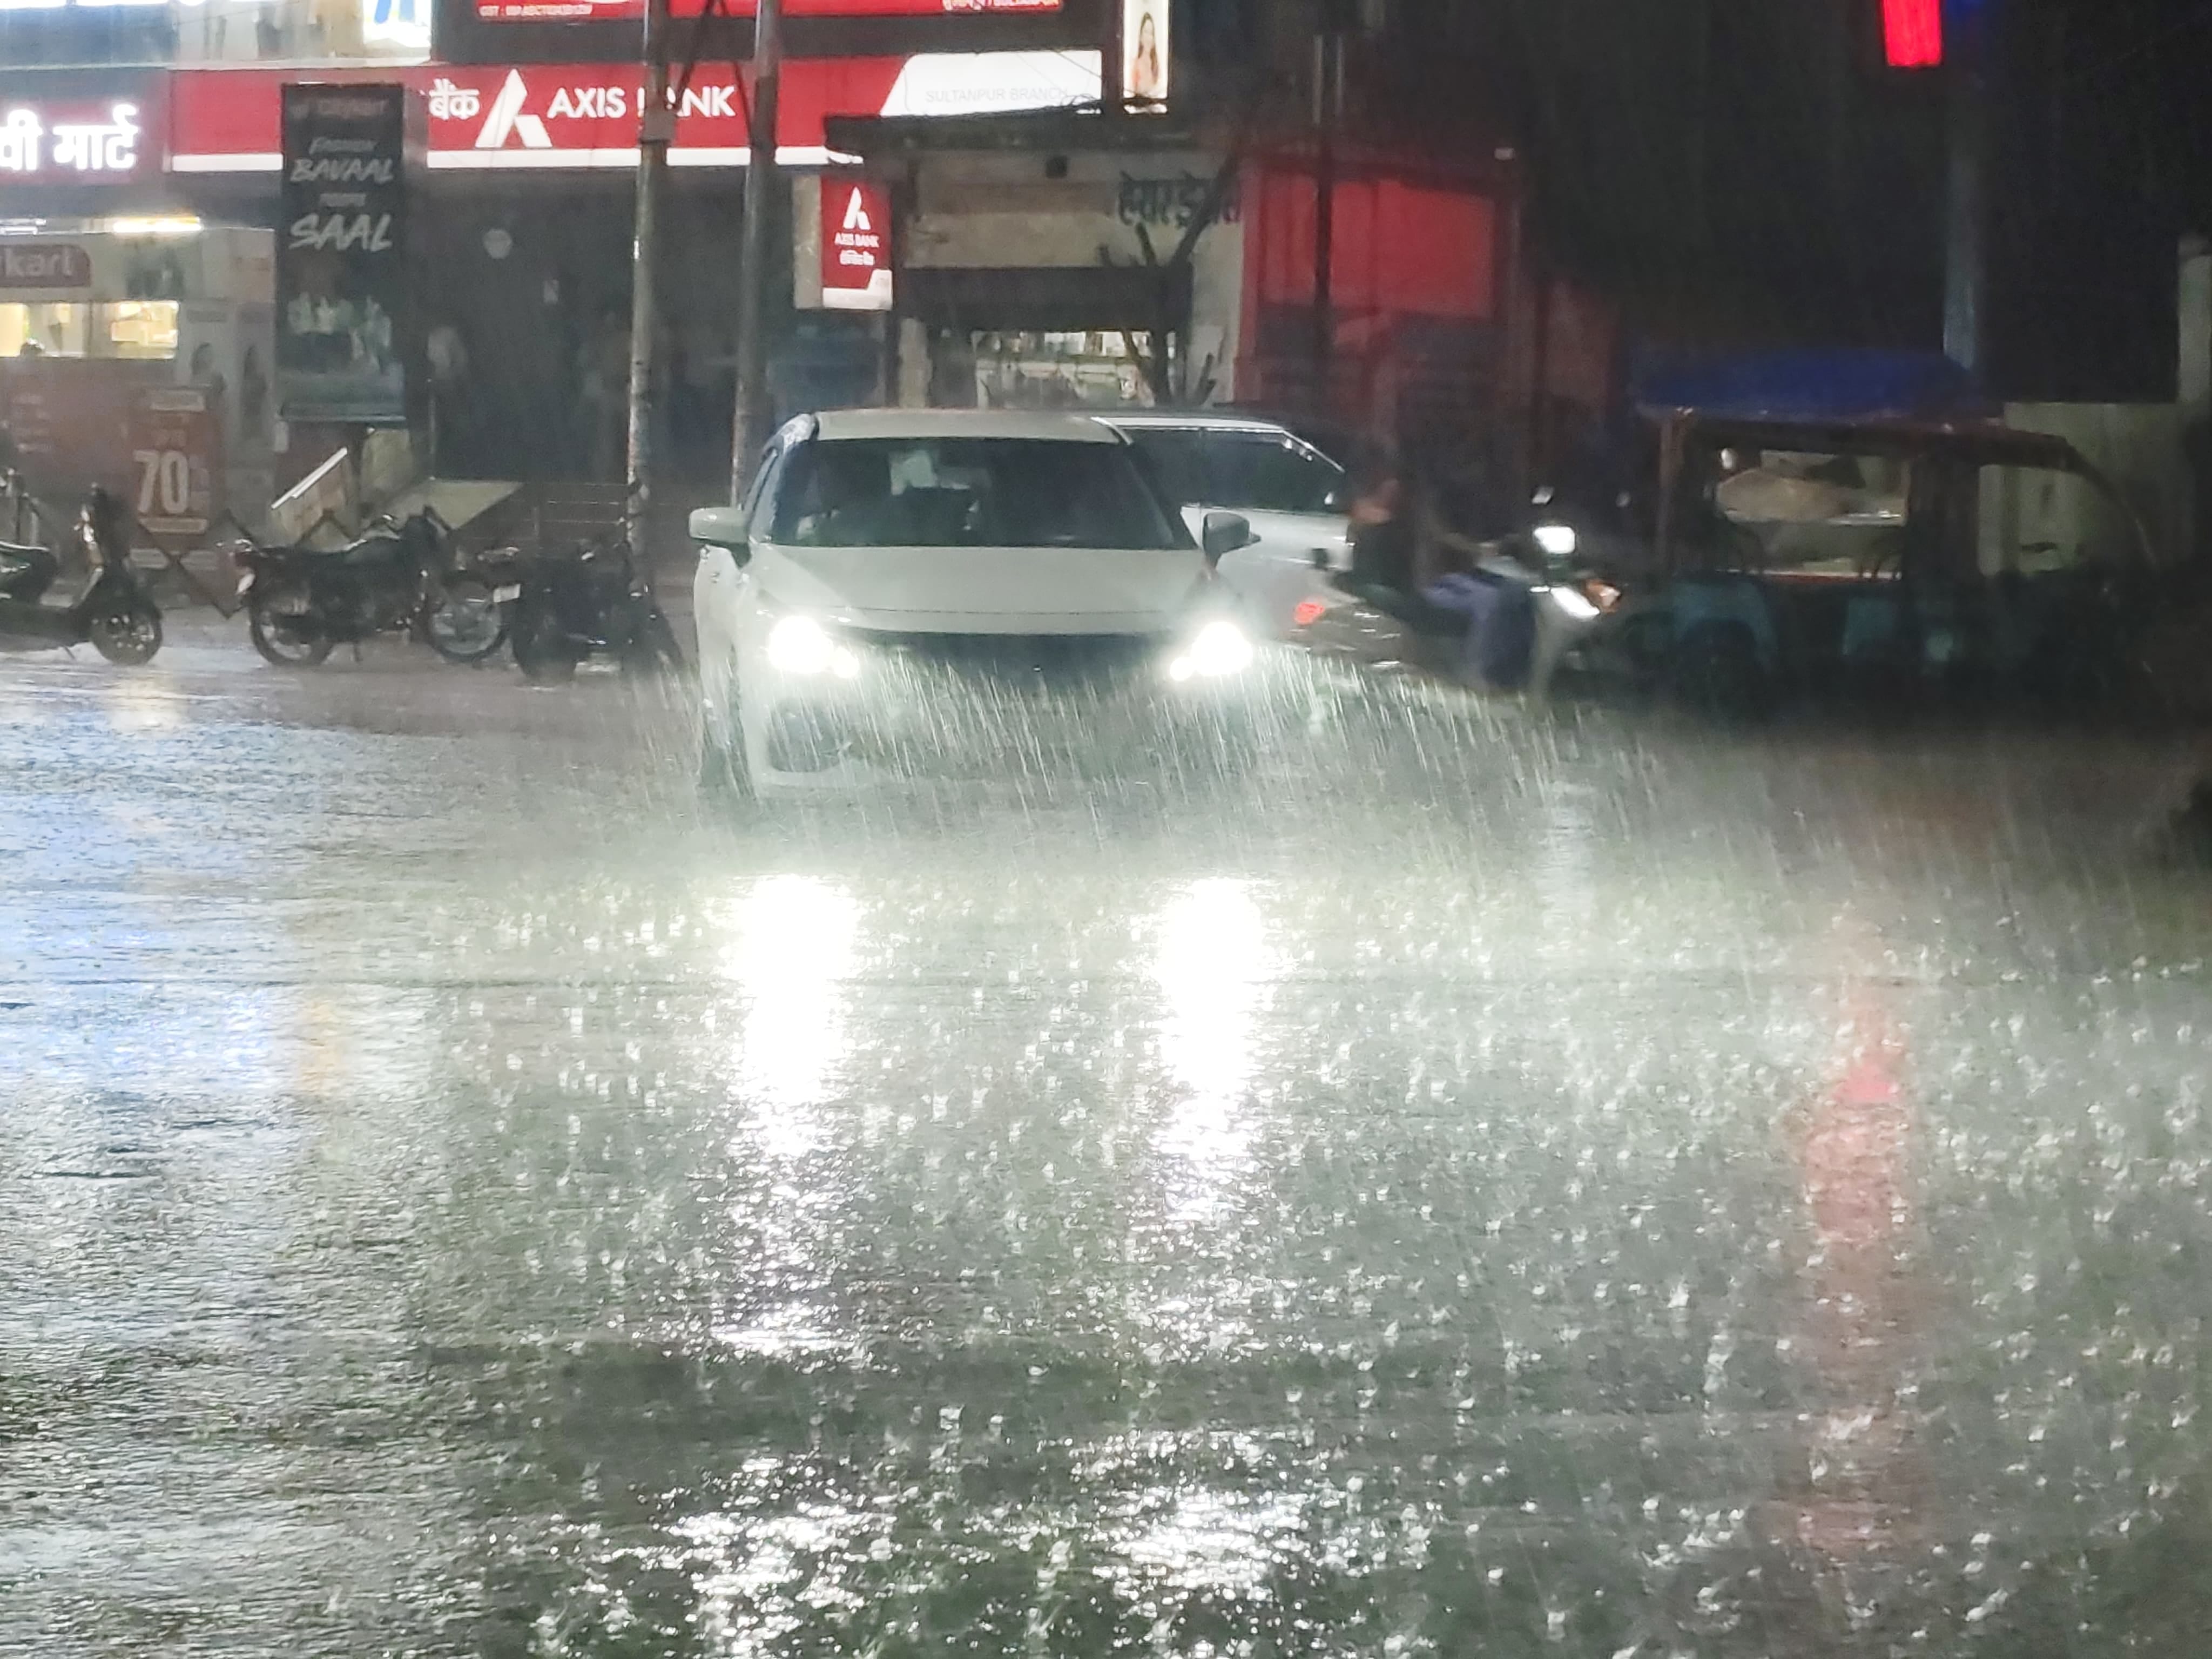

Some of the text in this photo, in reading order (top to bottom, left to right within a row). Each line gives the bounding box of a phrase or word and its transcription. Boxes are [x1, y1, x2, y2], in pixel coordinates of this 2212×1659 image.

[429, 78, 480, 120] बैंक
[547, 86, 736, 118] AXIS NK
[925, 88, 1006, 103] SULTANPUR
[52, 104, 139, 170] मार्ट
[288, 213, 393, 252] SAAL
[133, 449, 188, 514] 70
